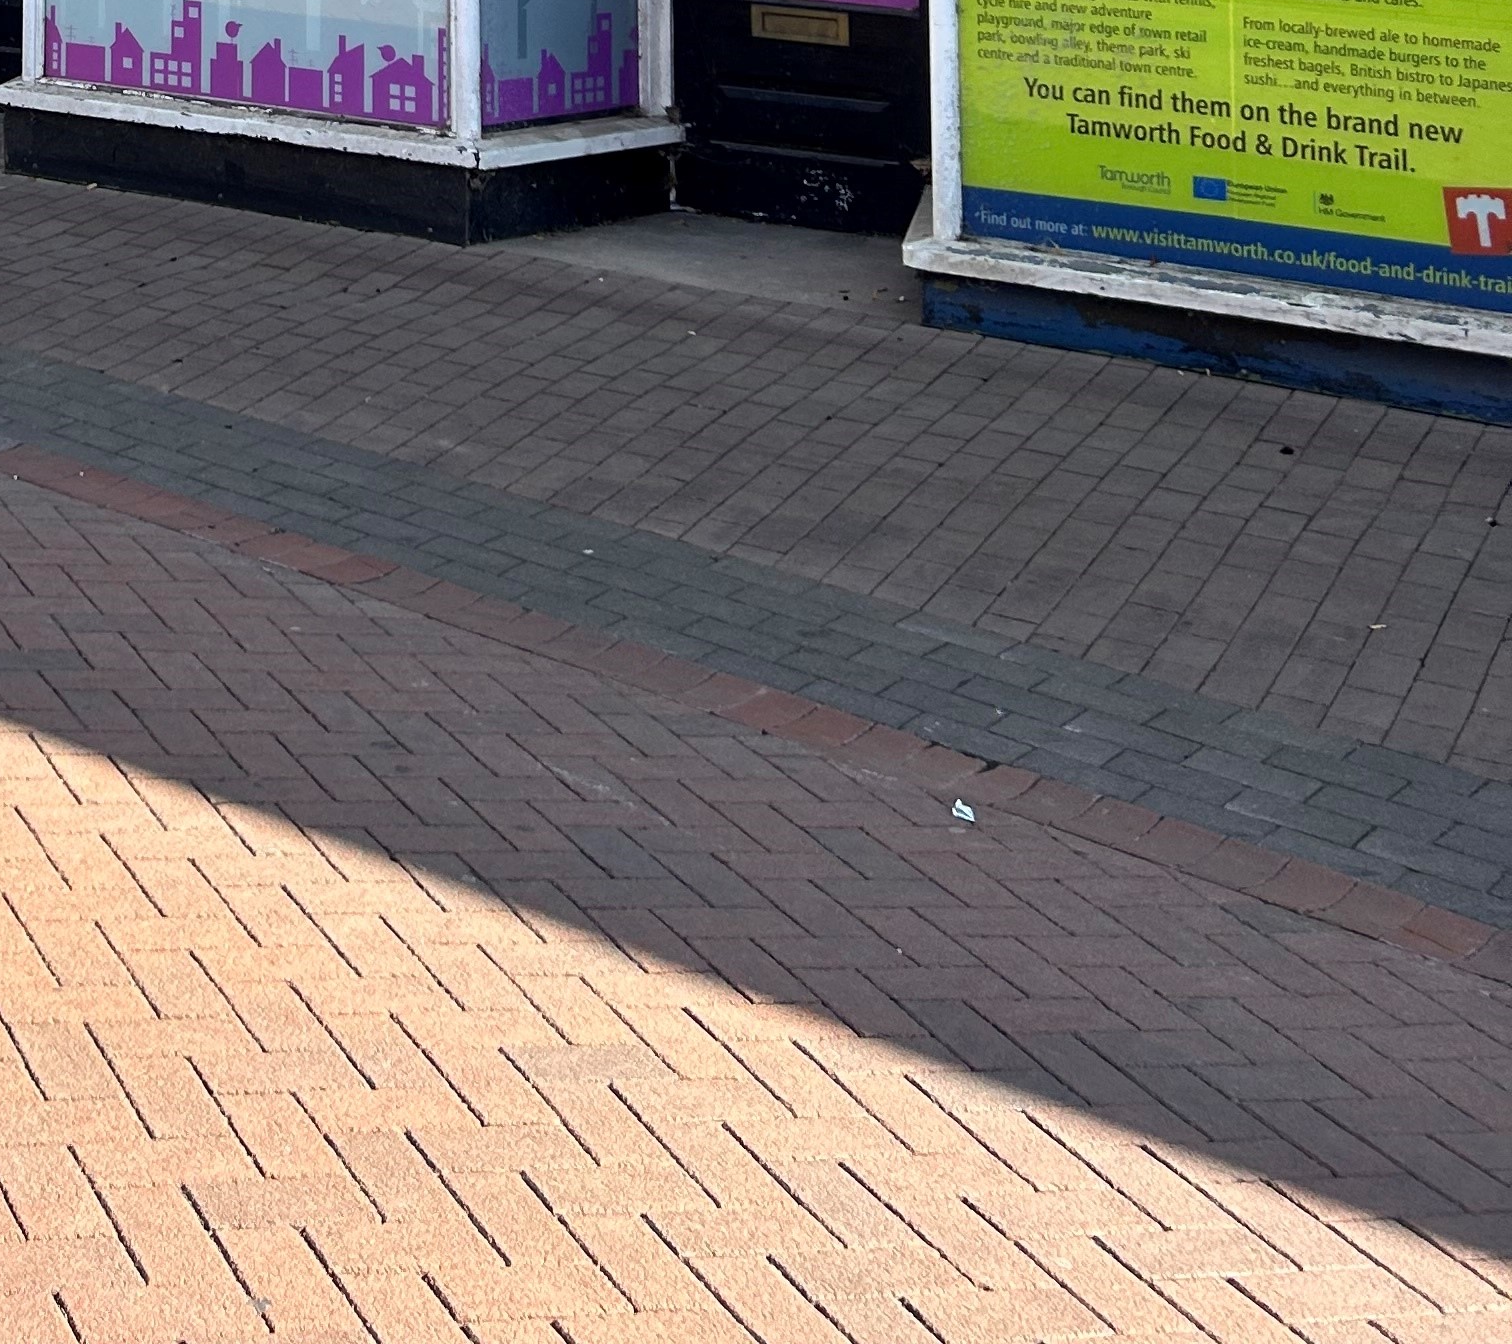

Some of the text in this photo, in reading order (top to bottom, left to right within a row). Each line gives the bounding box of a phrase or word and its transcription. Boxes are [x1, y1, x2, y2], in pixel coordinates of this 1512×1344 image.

[1024, 76, 1463, 144] You can find them on the brand new
[1066, 112, 1416, 172] Tamworth Food & Drink Trail.
[1098, 165, 1171, 187] Tamworth
[981, 210, 1006, 225] Find
[1011, 217, 1031, 229] out
[1036, 219, 1067, 233] more
[1071, 224, 1088, 236] at:
[1336, 208, 1386, 222] Government
